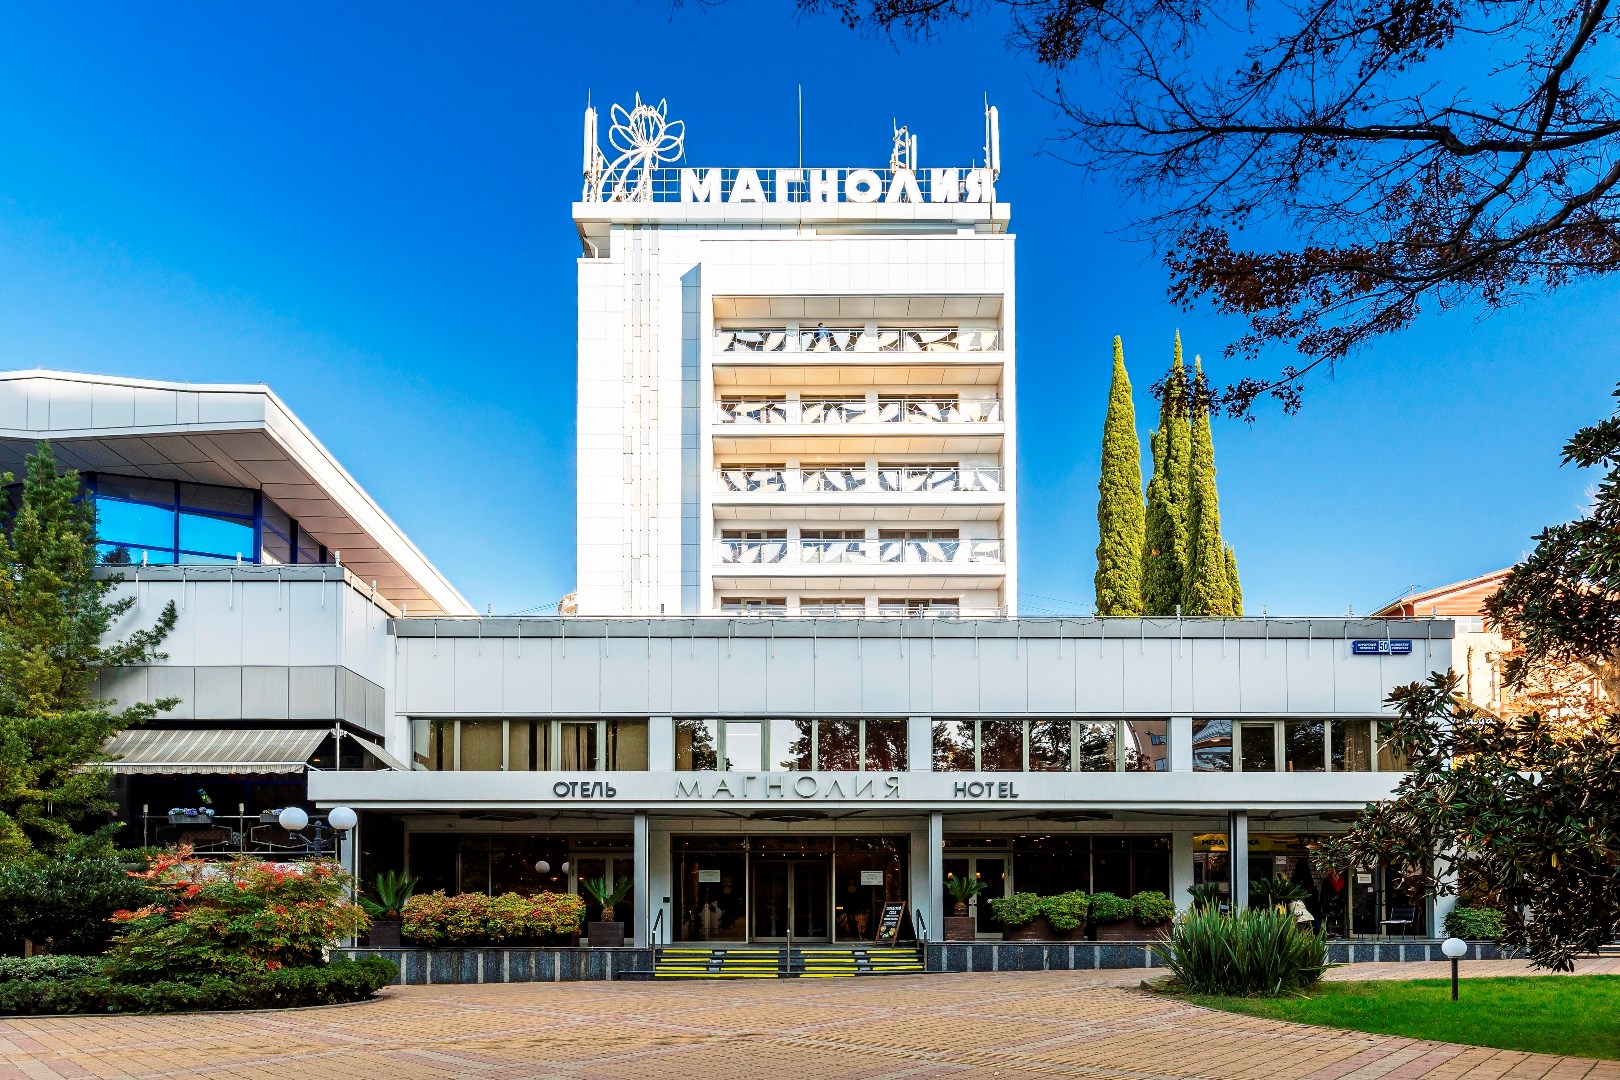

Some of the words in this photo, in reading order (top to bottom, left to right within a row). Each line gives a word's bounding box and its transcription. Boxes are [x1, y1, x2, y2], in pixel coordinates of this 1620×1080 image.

[680, 169, 992, 203] МАГНОЛИЯ
[1380, 641, 1389, 651] 50
[553, 781, 617, 798] ОТЕЛЬ
[675, 775, 900, 798] МАГНОЛИЯ
[954, 781, 1020, 798] HOTEL
